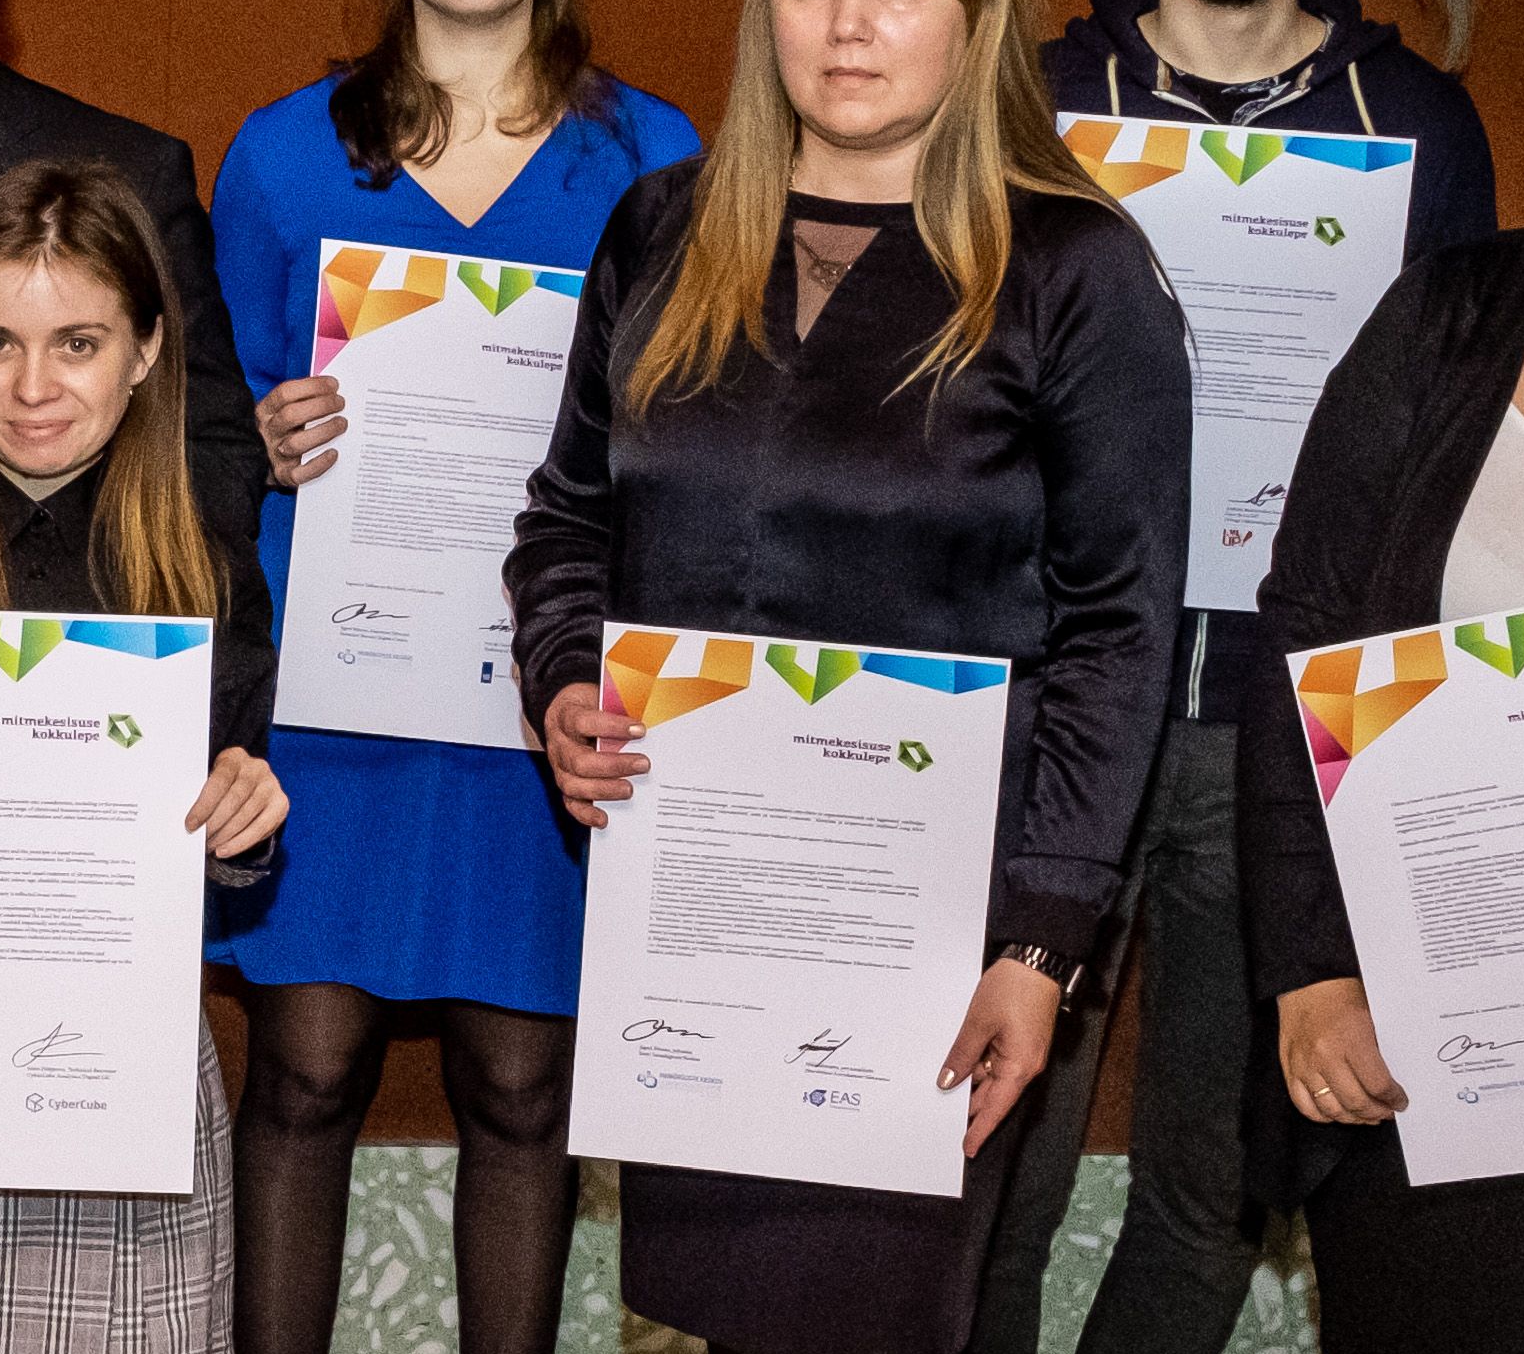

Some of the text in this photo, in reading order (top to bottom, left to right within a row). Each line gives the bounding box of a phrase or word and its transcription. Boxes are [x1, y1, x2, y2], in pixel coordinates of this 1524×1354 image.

[1221, 214, 1309, 228] mitmekesisuse
[1247, 225, 1309, 240] kokkulepe
[481, 344, 564, 360] mitmekesisuse
[1, 716, 101, 728] mitmekesisuse
[31, 728, 101, 743] kokkulepe
[793, 734, 892, 752] mitmekesisuse
[822, 747, 891, 765] kokkulepe
[48, 1097, 108, 1112] CyberCube
[830, 1090, 862, 1106] EAS
